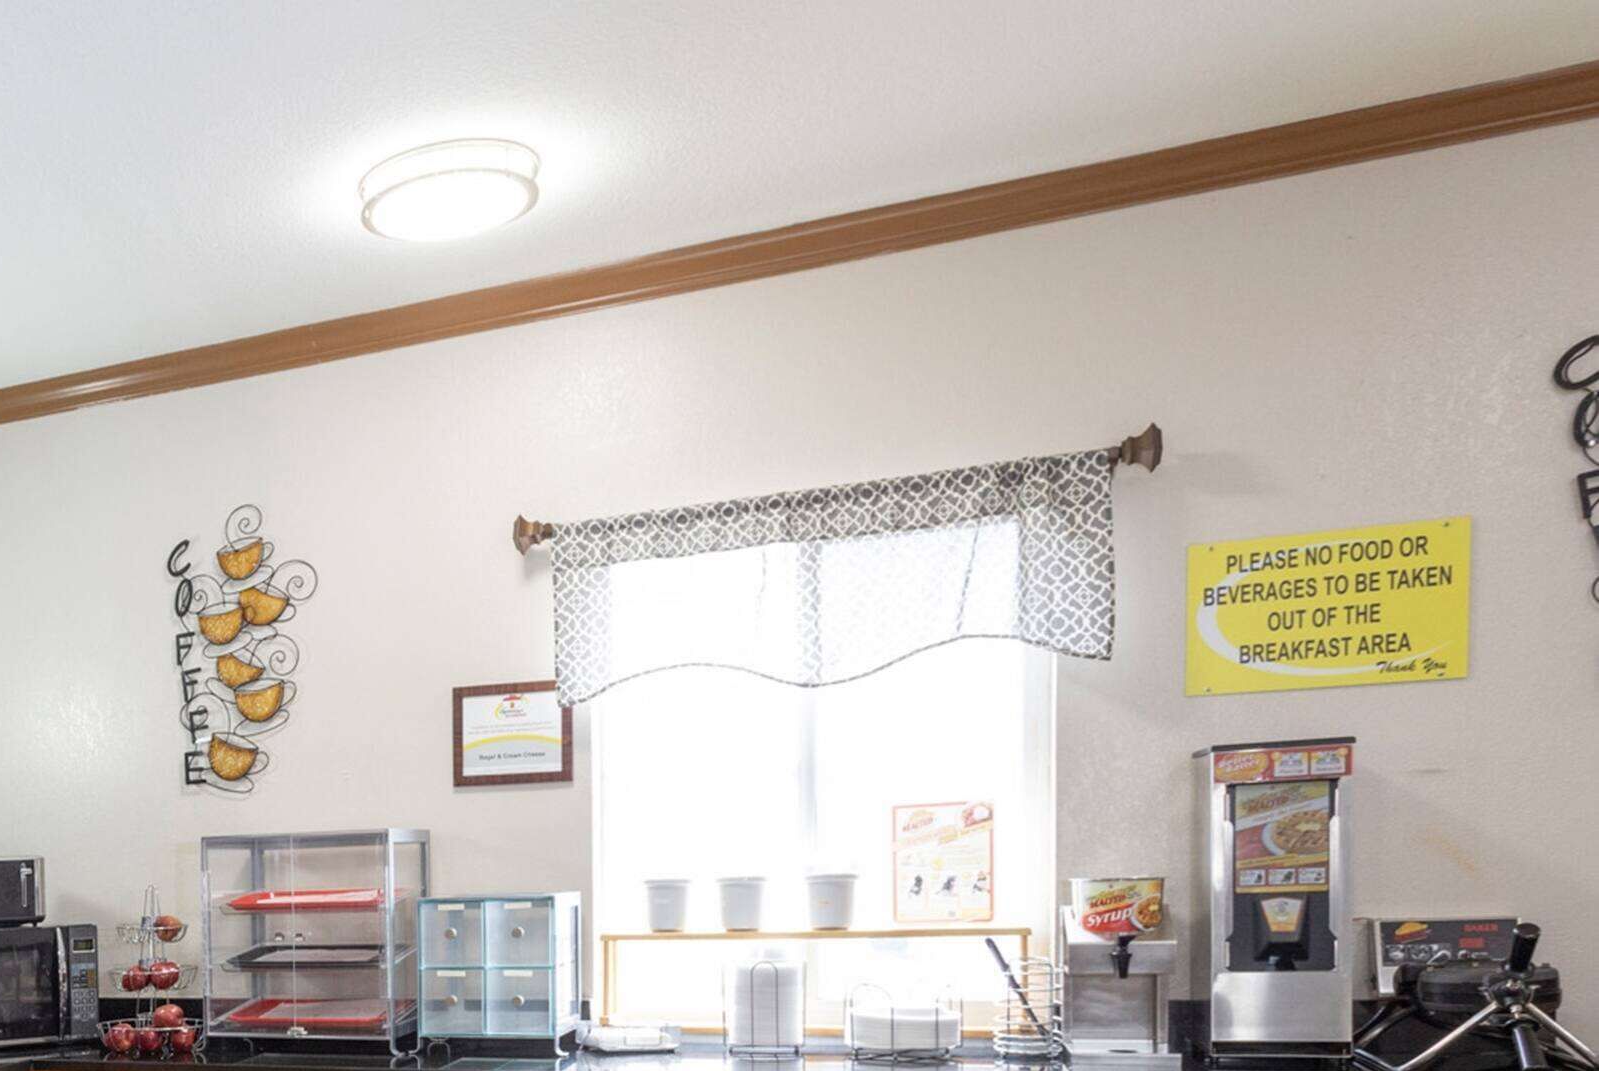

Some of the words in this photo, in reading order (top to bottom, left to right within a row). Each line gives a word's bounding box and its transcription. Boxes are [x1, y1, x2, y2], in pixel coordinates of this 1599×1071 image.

[1226, 548, 1299, 574] PLEASE
[1305, 545, 1333, 566] NO
[1338, 540, 1393, 563] FOOD
[1399, 536, 1428, 557] OR
[1203, 577, 1318, 606] BEVERAGES
[1324, 575, 1349, 596] TO
[1355, 572, 1381, 593] BE
[1386, 565, 1453, 590] TAKEN
[1267, 610, 1306, 631] OUT
[1312, 607, 1337, 627] OF
[1343, 603, 1381, 625] THE
[167, 540, 209, 785] COFFEE
[1239, 637, 1353, 664] BREAKFAST
[1357, 632, 1412, 656] AREA
[1376, 656, 1417, 674] Thank
[1422, 657, 1448, 673] You
